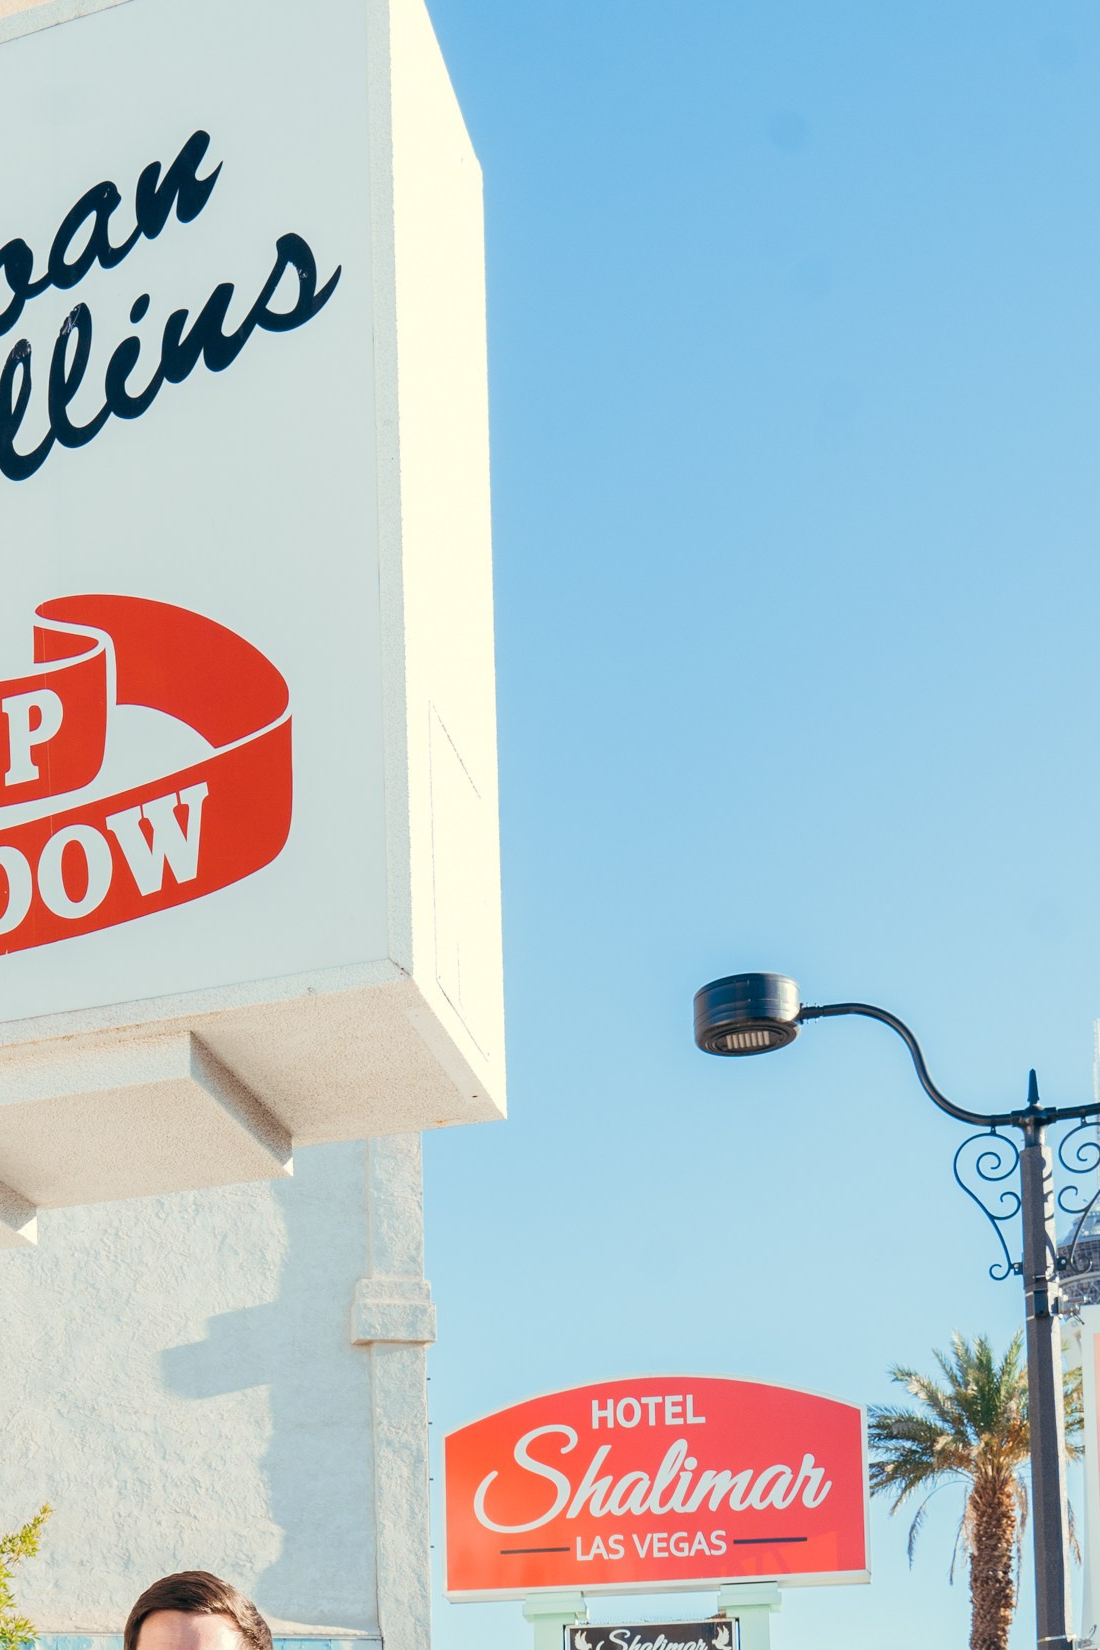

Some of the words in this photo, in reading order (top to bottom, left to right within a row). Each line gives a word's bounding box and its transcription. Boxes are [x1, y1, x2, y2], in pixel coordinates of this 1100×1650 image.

[591, 1394, 706, 1430] HOTEL
[473, 1424, 833, 1534] Shalimar
[575, 1534, 625, 1561] LAS
[631, 1530, 727, 1559] VEGAS
